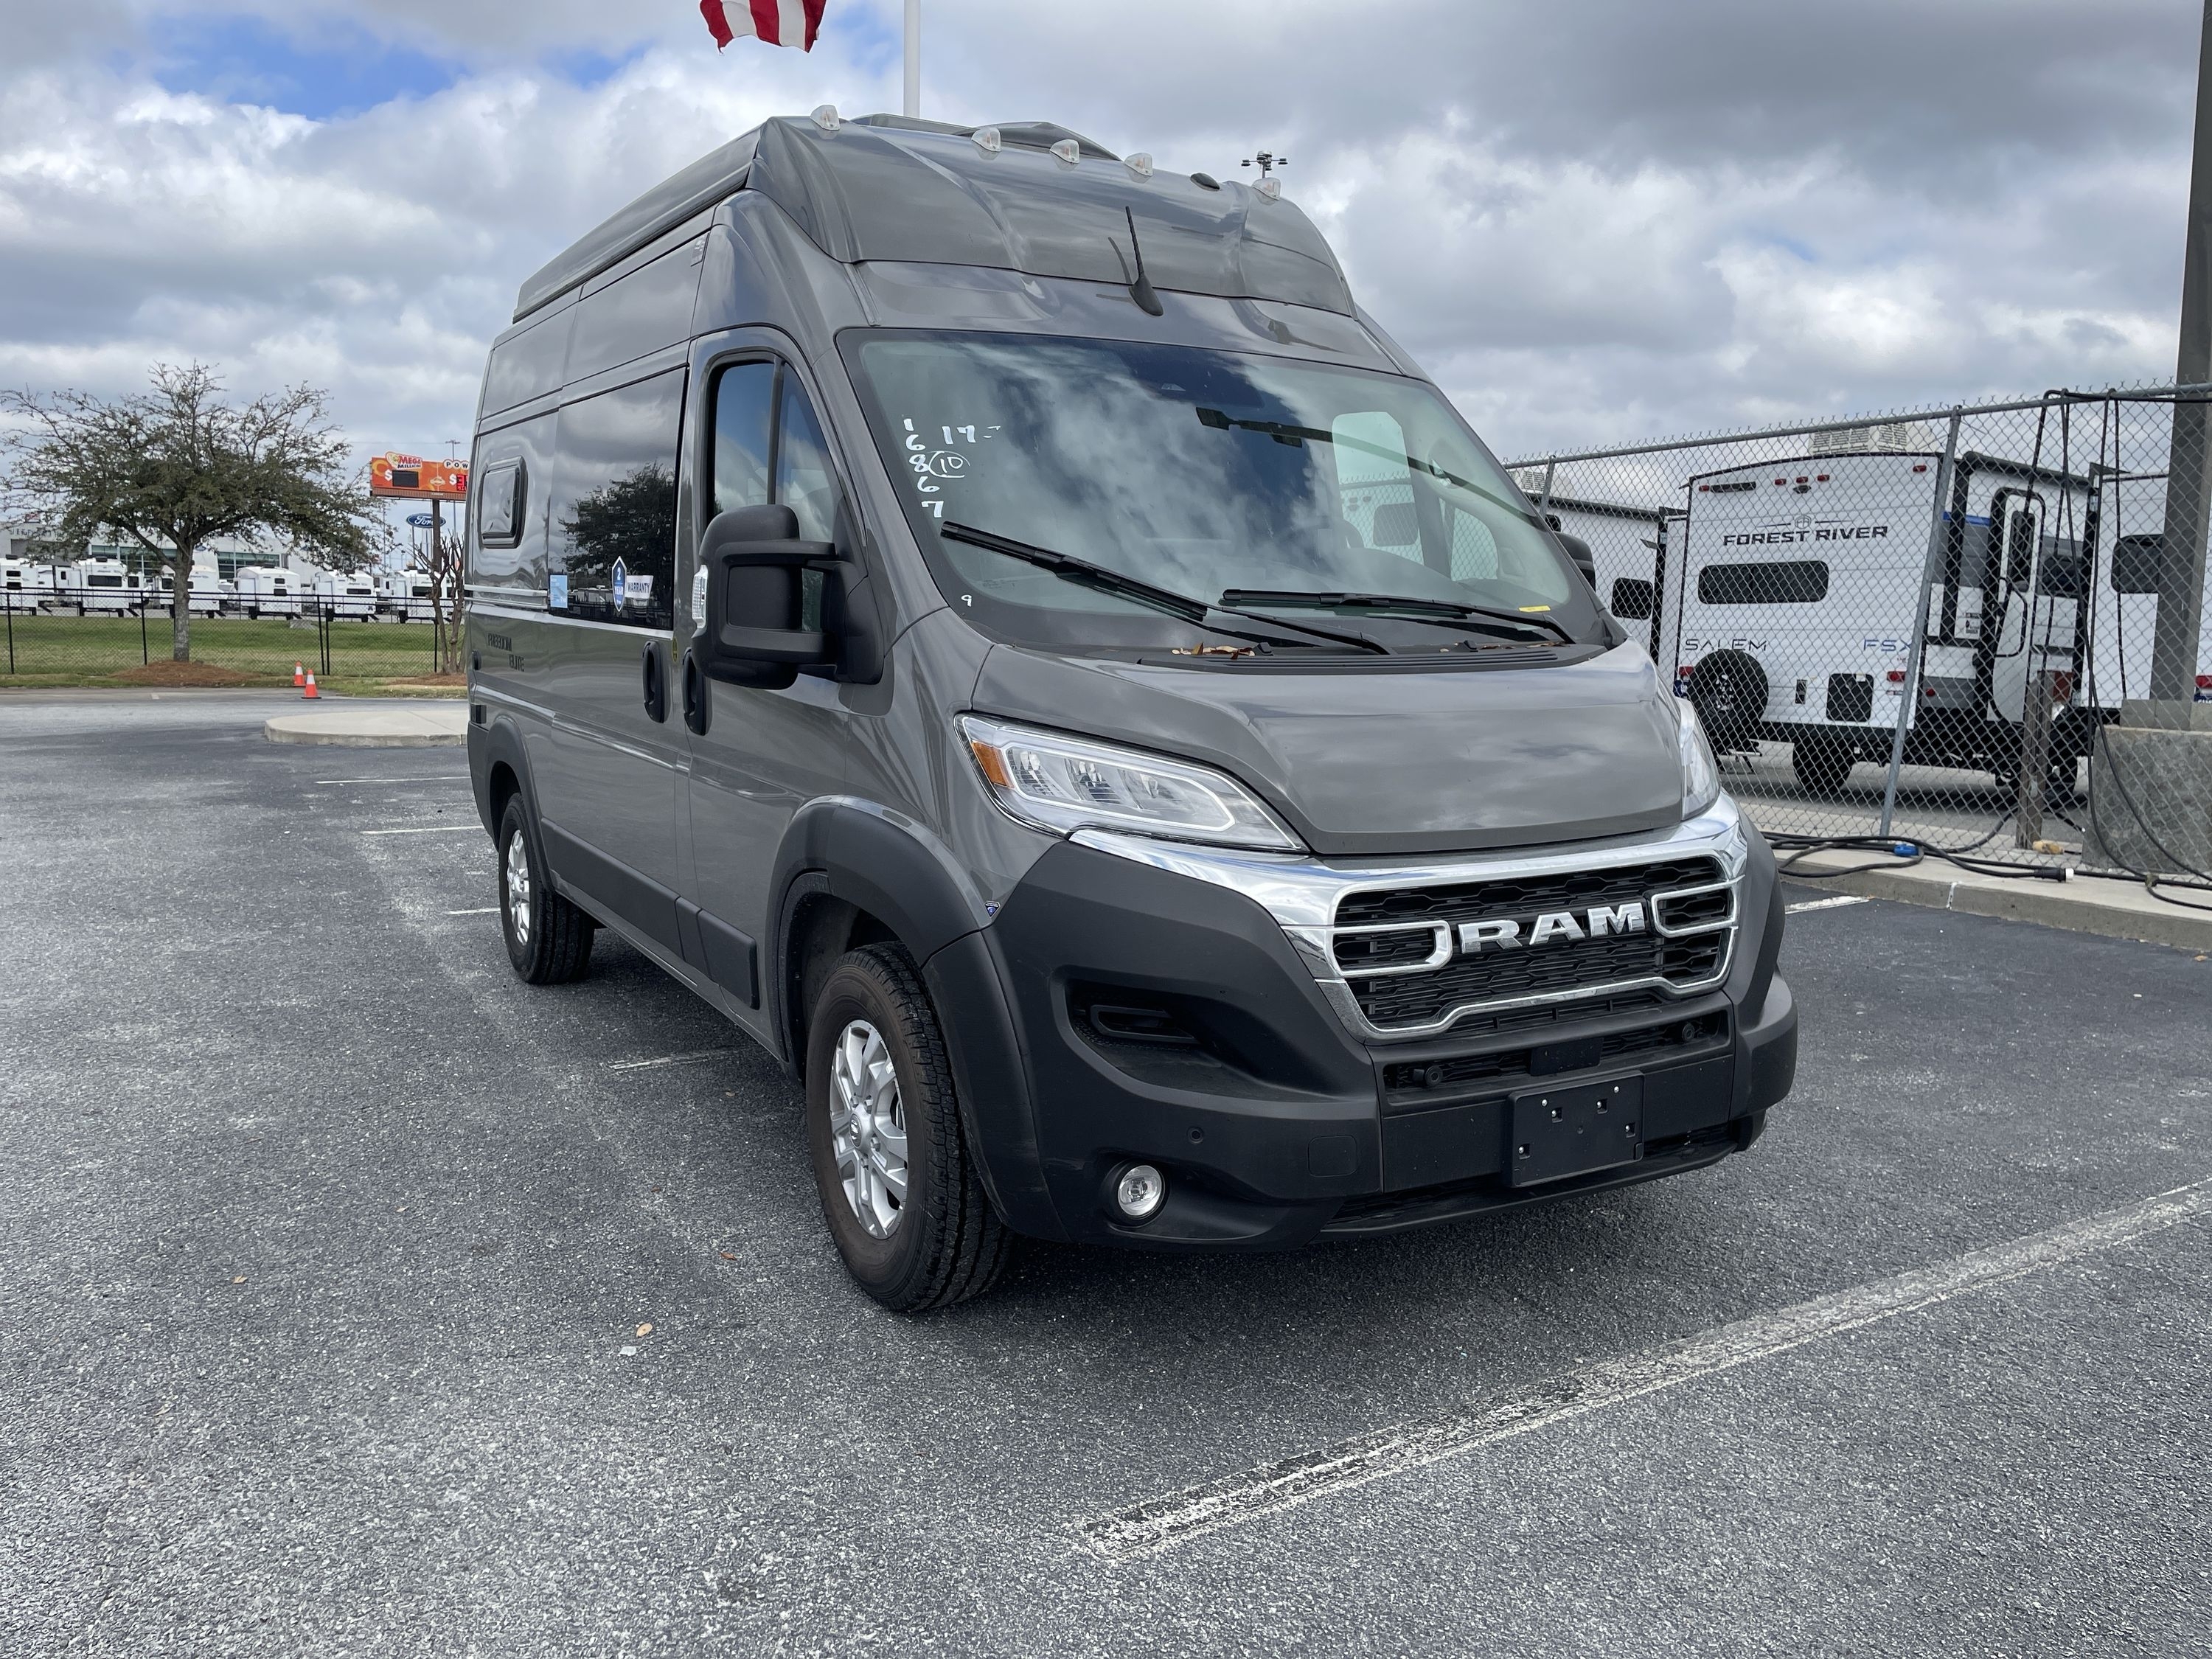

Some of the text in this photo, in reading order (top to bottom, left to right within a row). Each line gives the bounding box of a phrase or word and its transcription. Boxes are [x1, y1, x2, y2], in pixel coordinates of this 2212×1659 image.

[399, 456, 421, 465] MEGA
[1723, 526, 1888, 546] FOREST RIVER
[616, 566, 622, 581] 2
[627, 582, 650, 594] WARRANTY
[961, 594, 973, 607] 9
[1685, 639, 1767, 651] SALEM
[509, 653, 525, 672] ELITE
[1458, 902, 1646, 954] RAM
